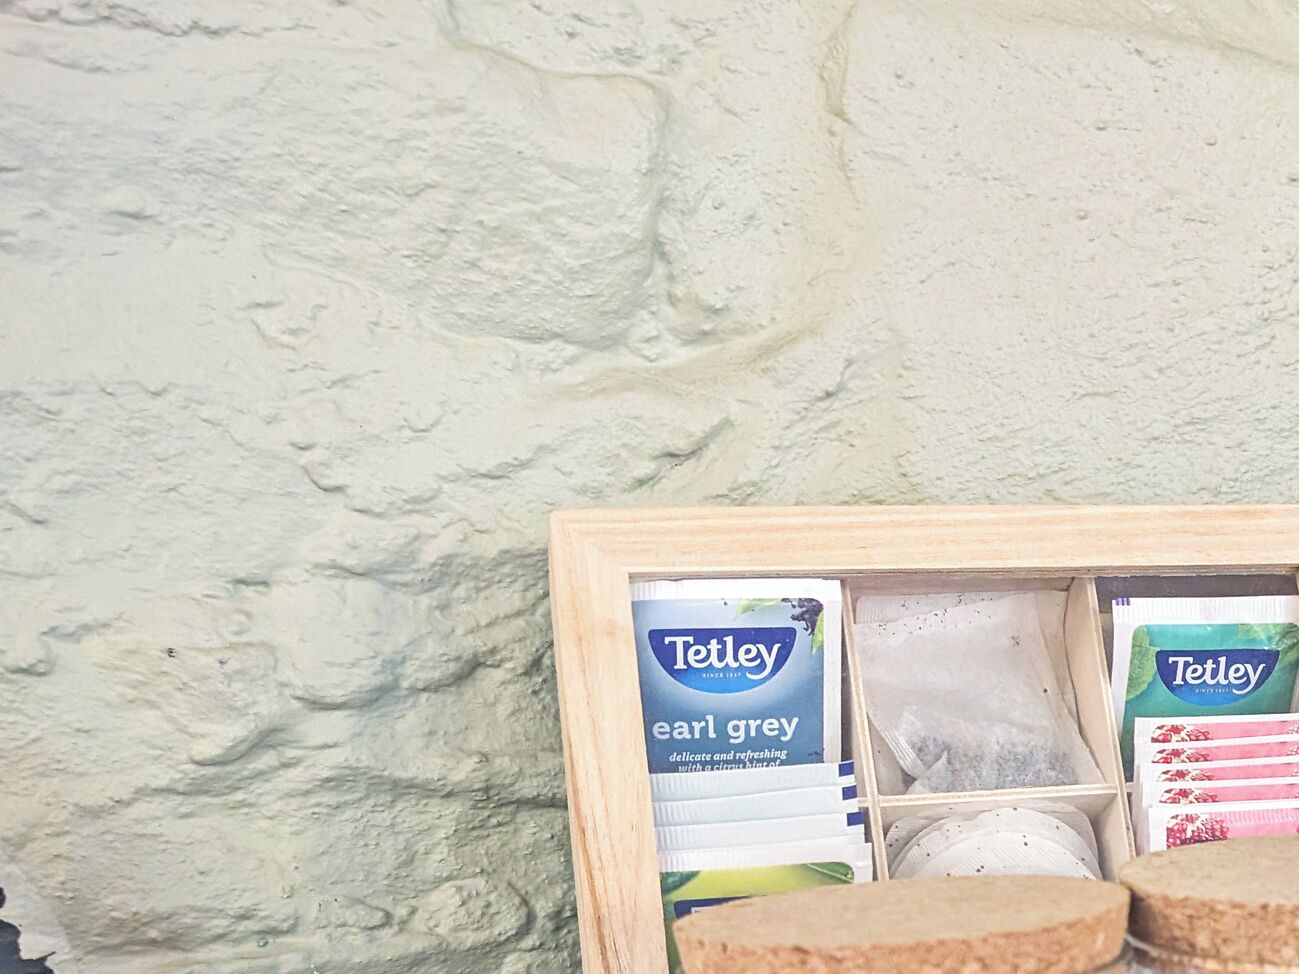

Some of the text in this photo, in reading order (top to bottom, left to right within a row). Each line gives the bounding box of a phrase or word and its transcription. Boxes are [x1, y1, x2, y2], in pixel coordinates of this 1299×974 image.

[664, 635, 781, 680] Tetley
[1168, 656, 1266, 695] Tetley
[652, 715, 799, 743] earl grey
[669, 749, 788, 762] delicate and refreshing
